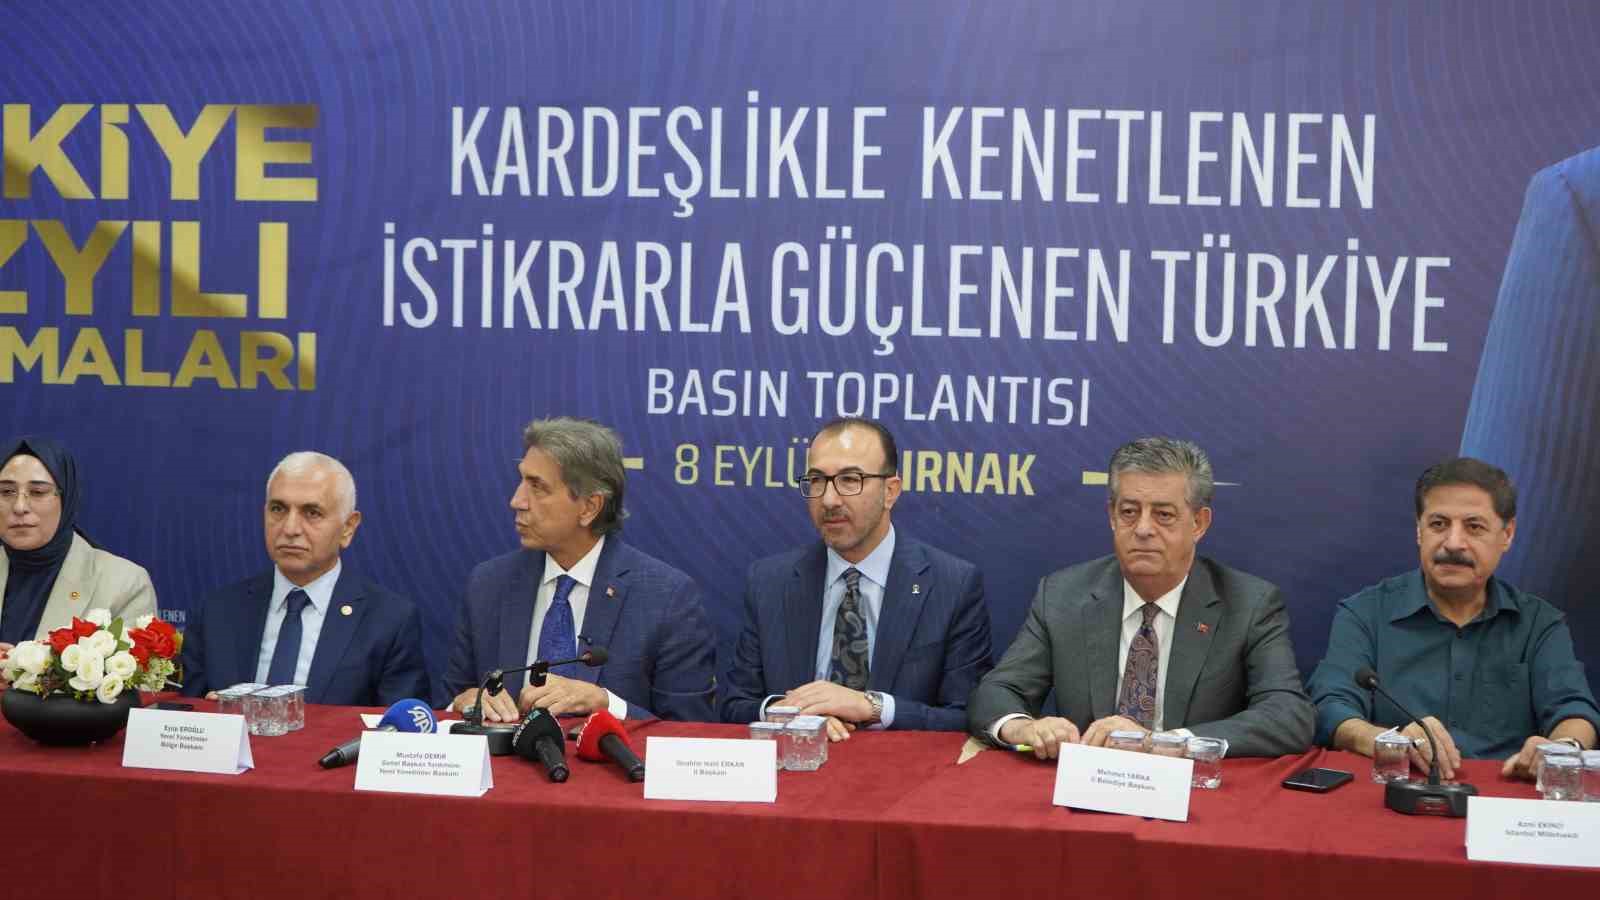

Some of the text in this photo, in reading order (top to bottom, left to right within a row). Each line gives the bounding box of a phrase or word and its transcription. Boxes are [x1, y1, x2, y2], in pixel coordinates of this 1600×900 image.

[452, 90, 1376, 218] KARDEŞLİKLE KENETLENEN
[383, 222, 1452, 356] İSTİKRARLA GÜÇLENEN TÜRKİYE
[0, 326, 317, 391] MALARI
[647, 368, 1091, 427] BASIN TOPLANTISI
[673, 437, 1035, 497] 8 EYLÜ IRNAK
